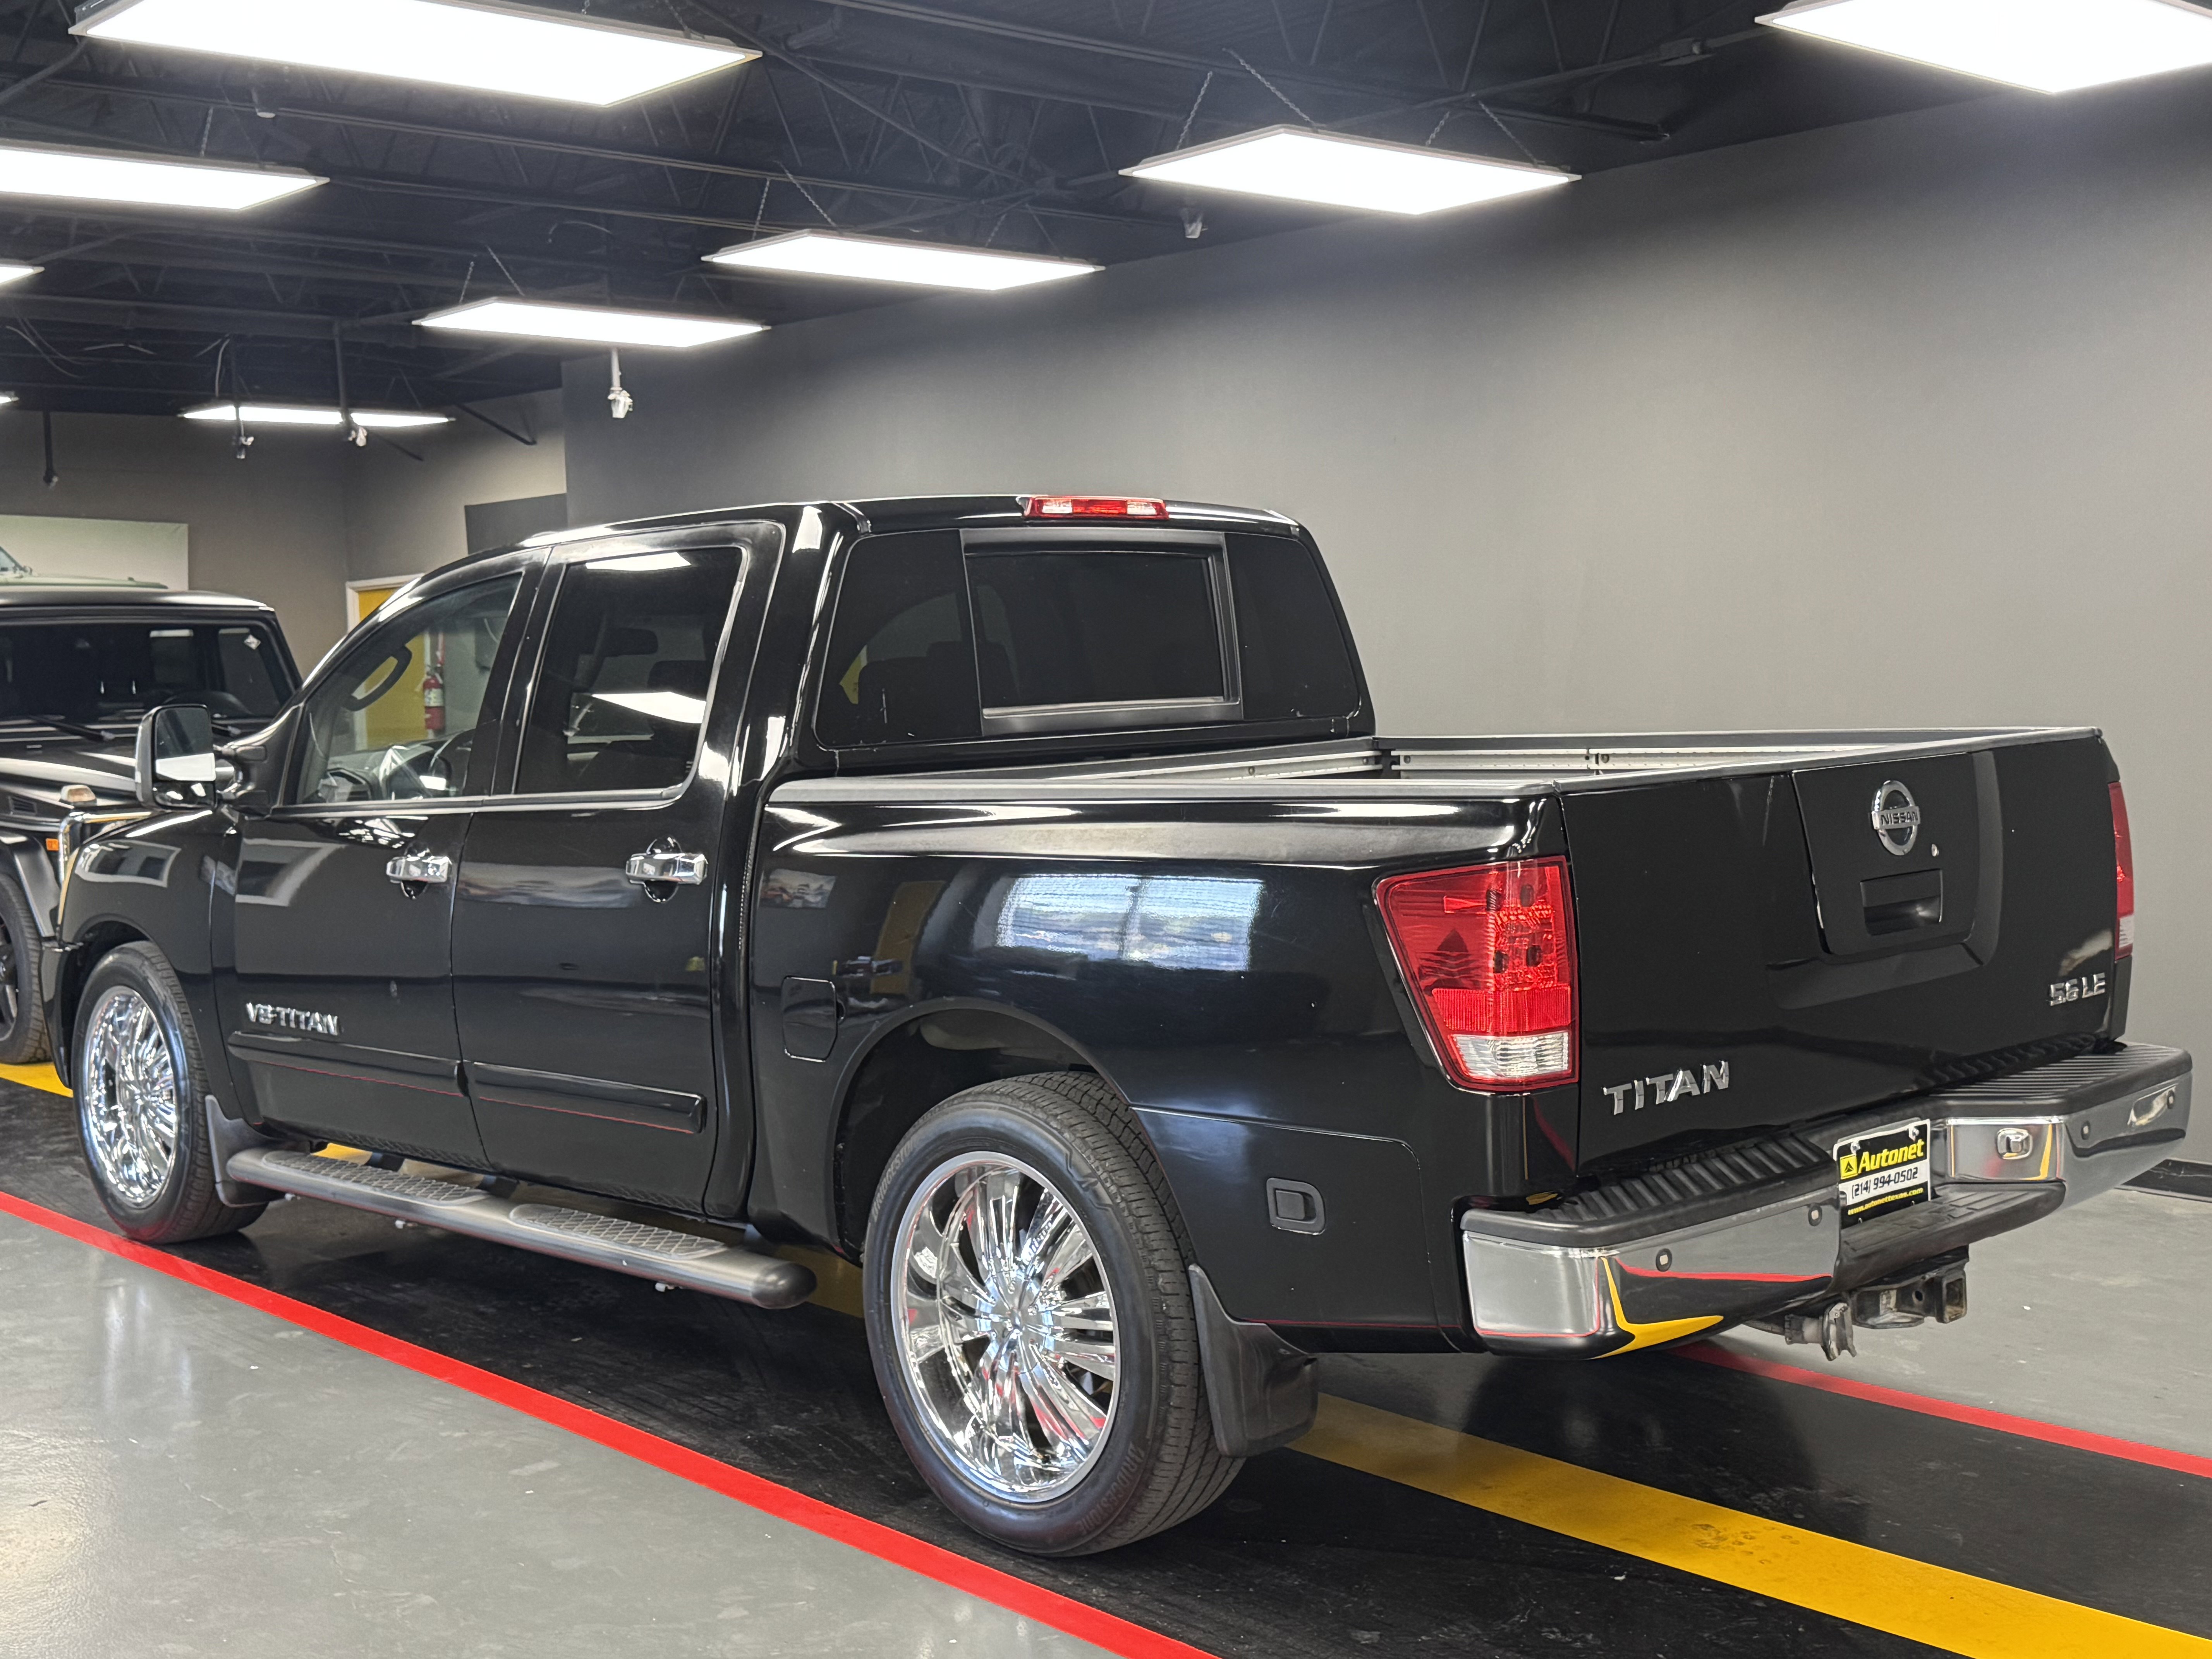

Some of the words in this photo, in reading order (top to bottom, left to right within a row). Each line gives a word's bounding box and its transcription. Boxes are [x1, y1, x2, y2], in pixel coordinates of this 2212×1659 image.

[1881, 811, 1918, 825] NISSAN
[2082, 972, 2106, 998] LE
[276, 1007, 338, 1036] TITAN
[1602, 1060, 1729, 1115] TITAN
[1858, 1139, 1925, 1174] Autonet
[871, 1135, 920, 1223] BRIDGESTO
[1852, 1180, 1871, 1199] (214)
[1873, 1166, 1918, 1190] 994-0502
[1848, 1187, 1924, 1216] www.autonettexas.com
